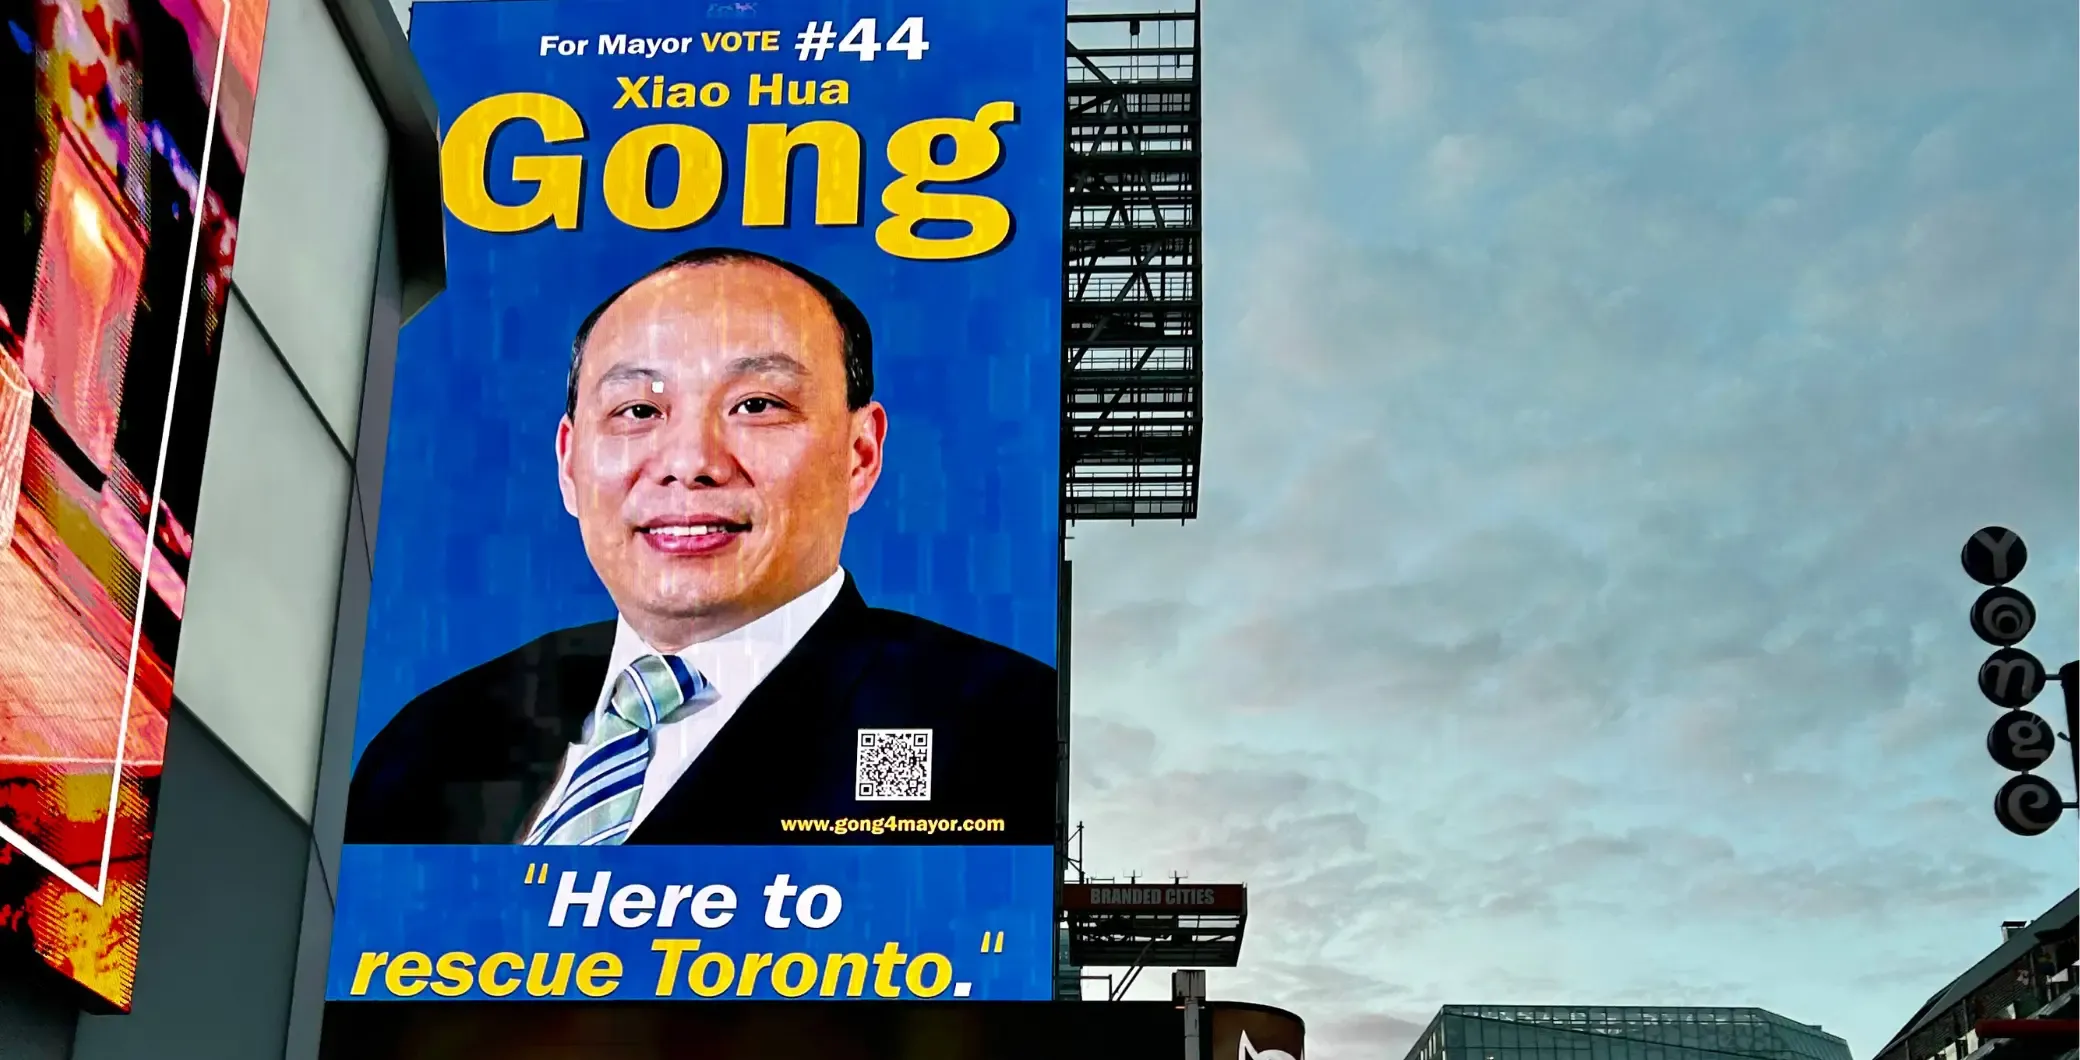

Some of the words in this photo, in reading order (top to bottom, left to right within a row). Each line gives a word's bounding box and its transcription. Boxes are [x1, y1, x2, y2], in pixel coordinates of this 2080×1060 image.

[540, 36, 588, 56] For
[598, 33, 692, 58] Mayor
[701, 31, 781, 53] VOTE
[795, 17, 930, 61] #44
[613, 76, 730, 108] Xiao
[748, 73, 849, 106] Hua
[441, 91, 1014, 259] Gong
[1972, 527, 2057, 831] Yonge
[781, 816, 1005, 835] www.gong4mayor.com
[763, 874, 843, 929] to
[1090, 887, 1163, 905] BRANDED
[1165, 888, 1215, 905] CITIES
[350, 952, 624, 997] rescue
